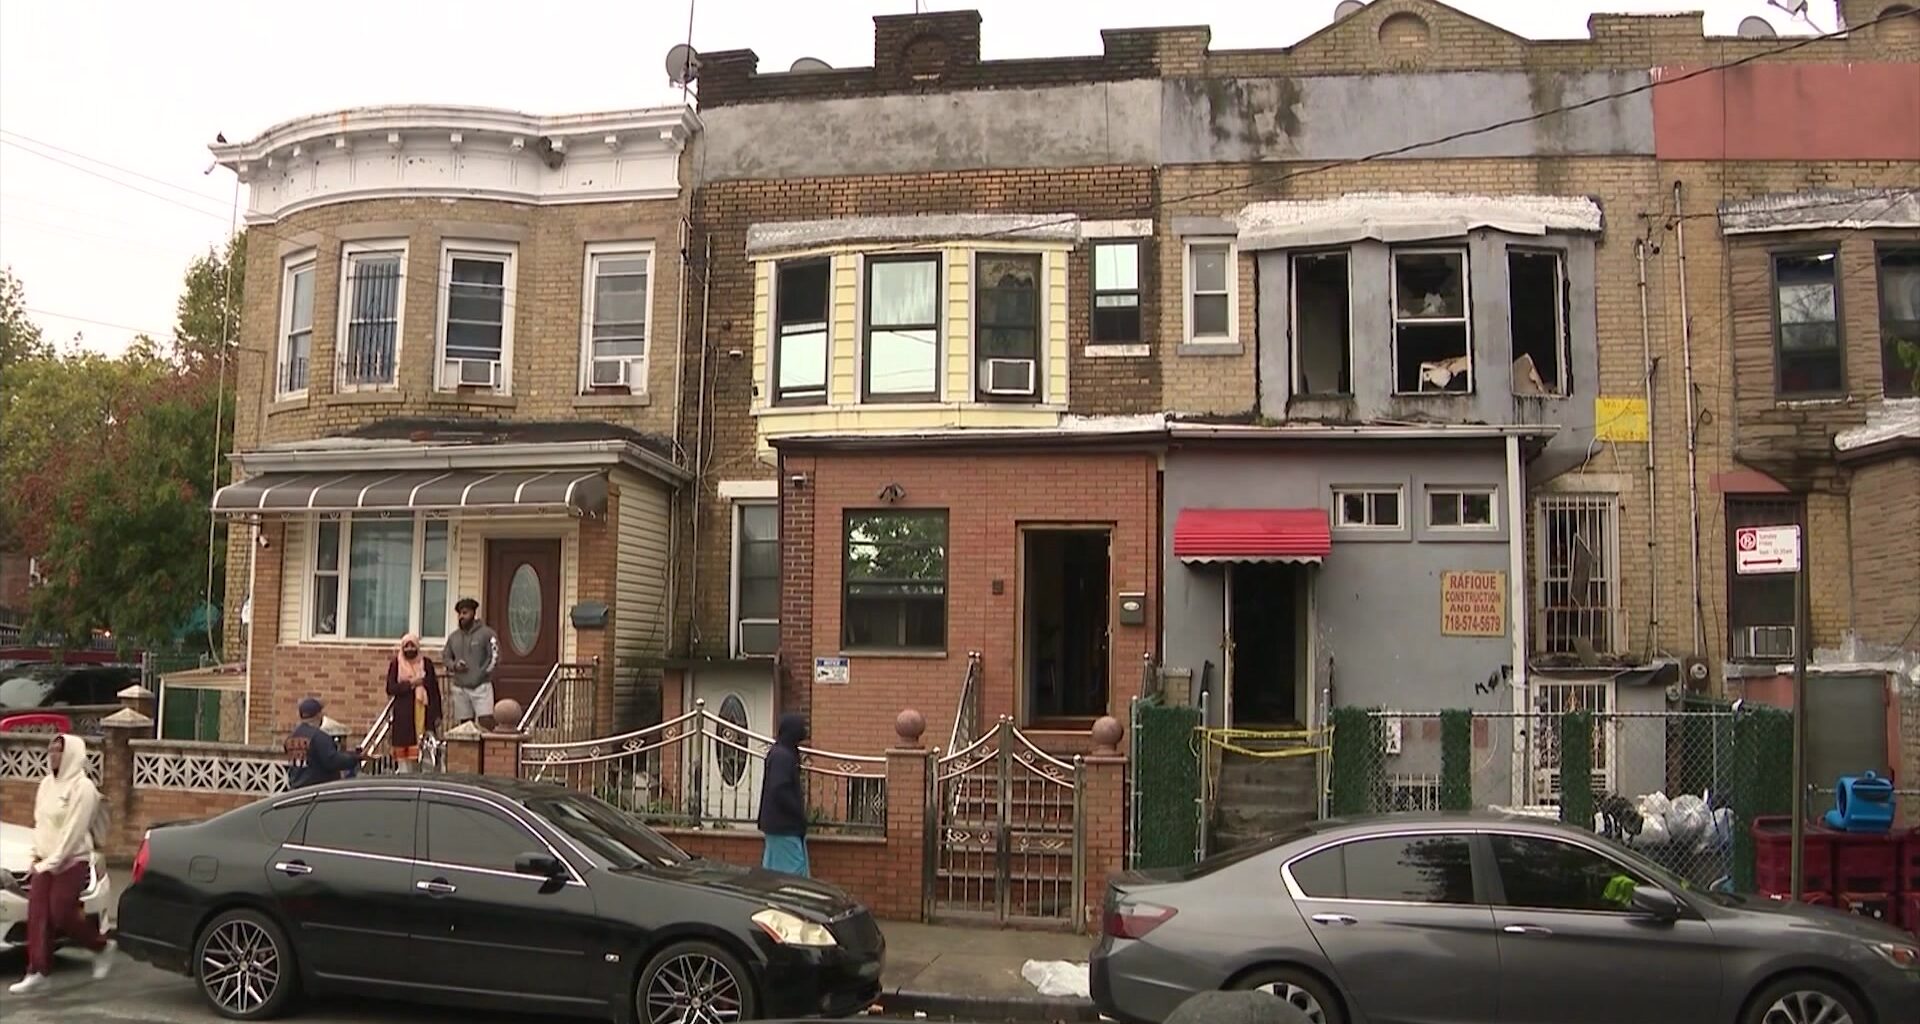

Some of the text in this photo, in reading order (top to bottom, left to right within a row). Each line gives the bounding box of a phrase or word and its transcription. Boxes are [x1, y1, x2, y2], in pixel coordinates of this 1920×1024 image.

[1450, 575, 1497, 590] RAFIQUE
[1445, 591, 1501, 603] CONSTRUCTION
[1449, 604, 1471, 613] AND
[1445, 615, 1501, 632] 718-574-5679
